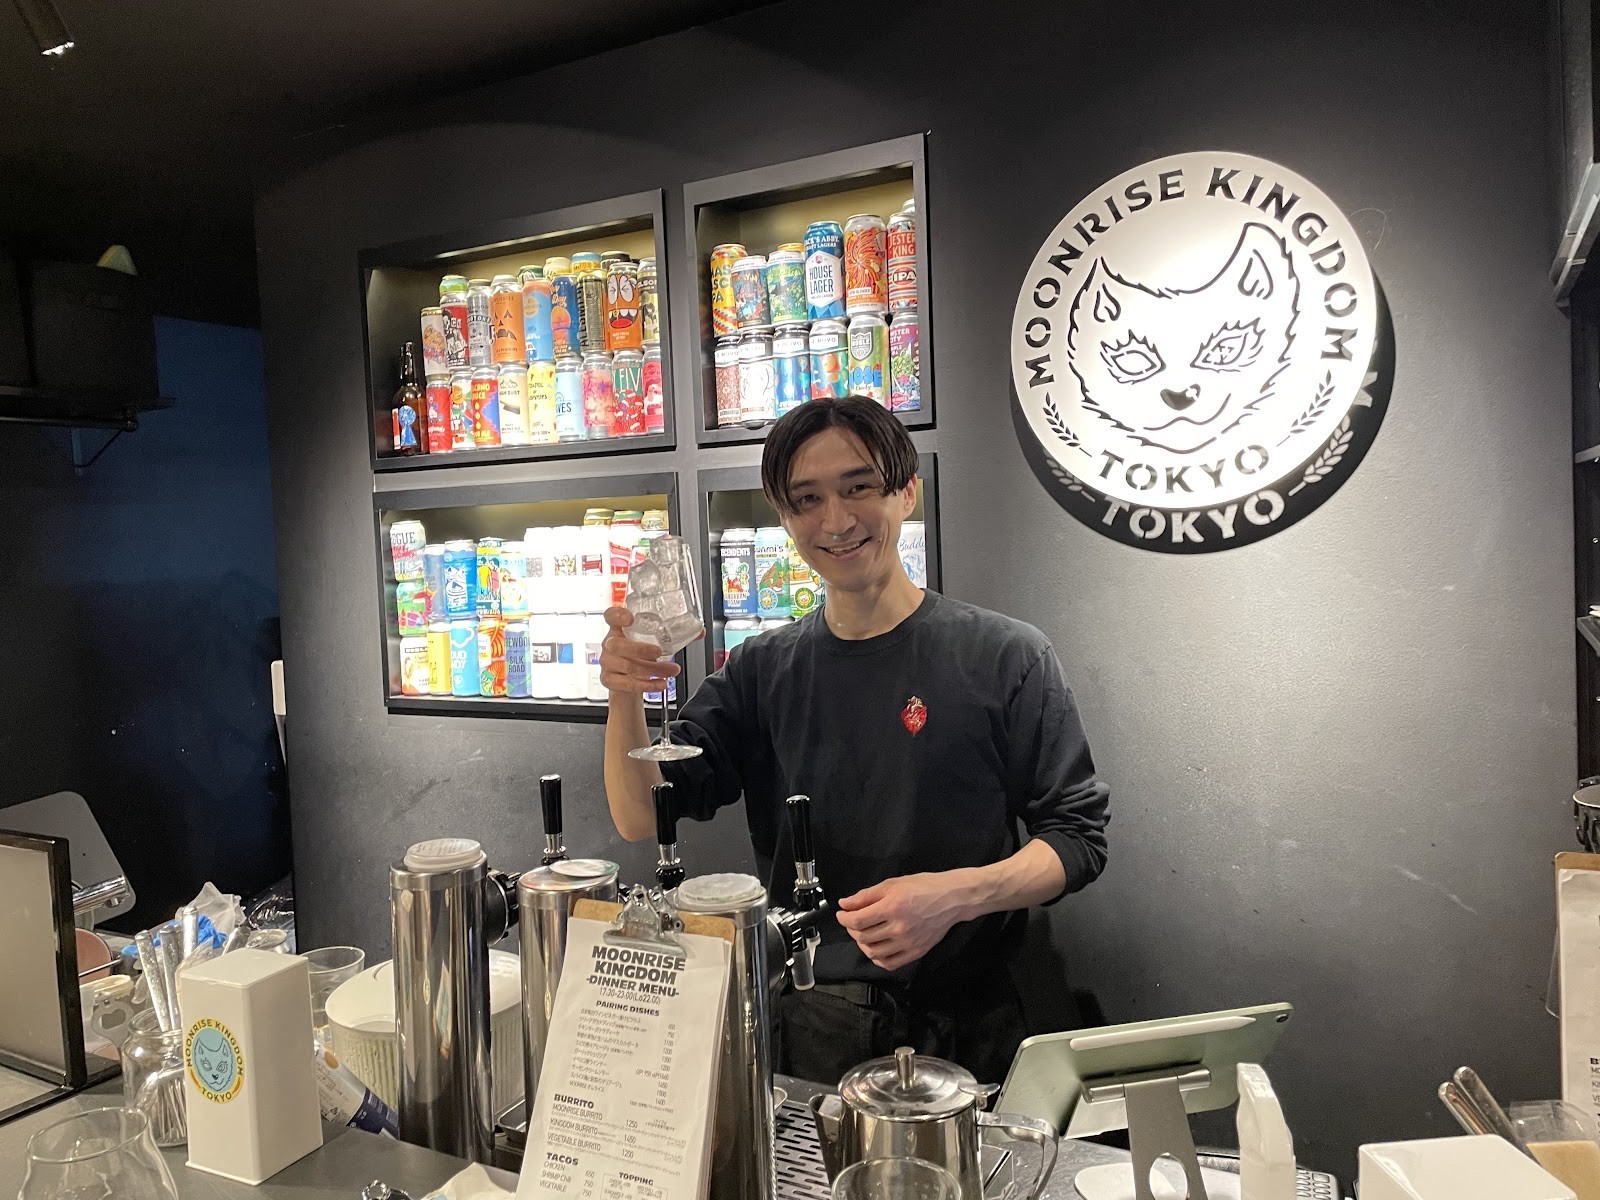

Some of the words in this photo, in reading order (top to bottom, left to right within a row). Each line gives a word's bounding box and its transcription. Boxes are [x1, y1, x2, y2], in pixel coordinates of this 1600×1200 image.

[809, 264, 833, 279] HOUSE
[893, 271, 916, 282] IPA
[1025, 168, 1186, 390] MOONRISE
[1205, 166, 1359, 363] KINGDOM
[809, 279, 834, 294] LAGER
[1098, 443, 1270, 495] TOKYO
[1102, 488, 1286, 544] TOKYO
[509, 655, 524, 665] SILK
[591, 945, 687, 971] MOONRISE
[594, 960, 677, 985] KINGDOM
[586, 975, 637, 991] -DINNER
[638, 982, 680, 997] MENU-
[596, 1000, 628, 1012] PAIRING
[629, 1006, 660, 1017] DISHES
[185, 1018, 212, 1068] MOONRISE
[215, 1021, 243, 1076] KINGDOM
[201, 1086, 232, 1103] TOKYO
[553, 1093, 595, 1109] BURRITO
[552, 1102, 579, 1117] MOONRISE
[579, 1109, 603, 1121] BURRITO
[550, 1117, 575, 1131] KINGDOM
[575, 1124, 599, 1136] BURRITO
[547, 1132, 577, 1147] VEGETABLE
[577, 1140, 602, 1152] BURRITO
[546, 1152, 579, 1166] TACOS
[619, 1171, 654, 1186] TOPPING
